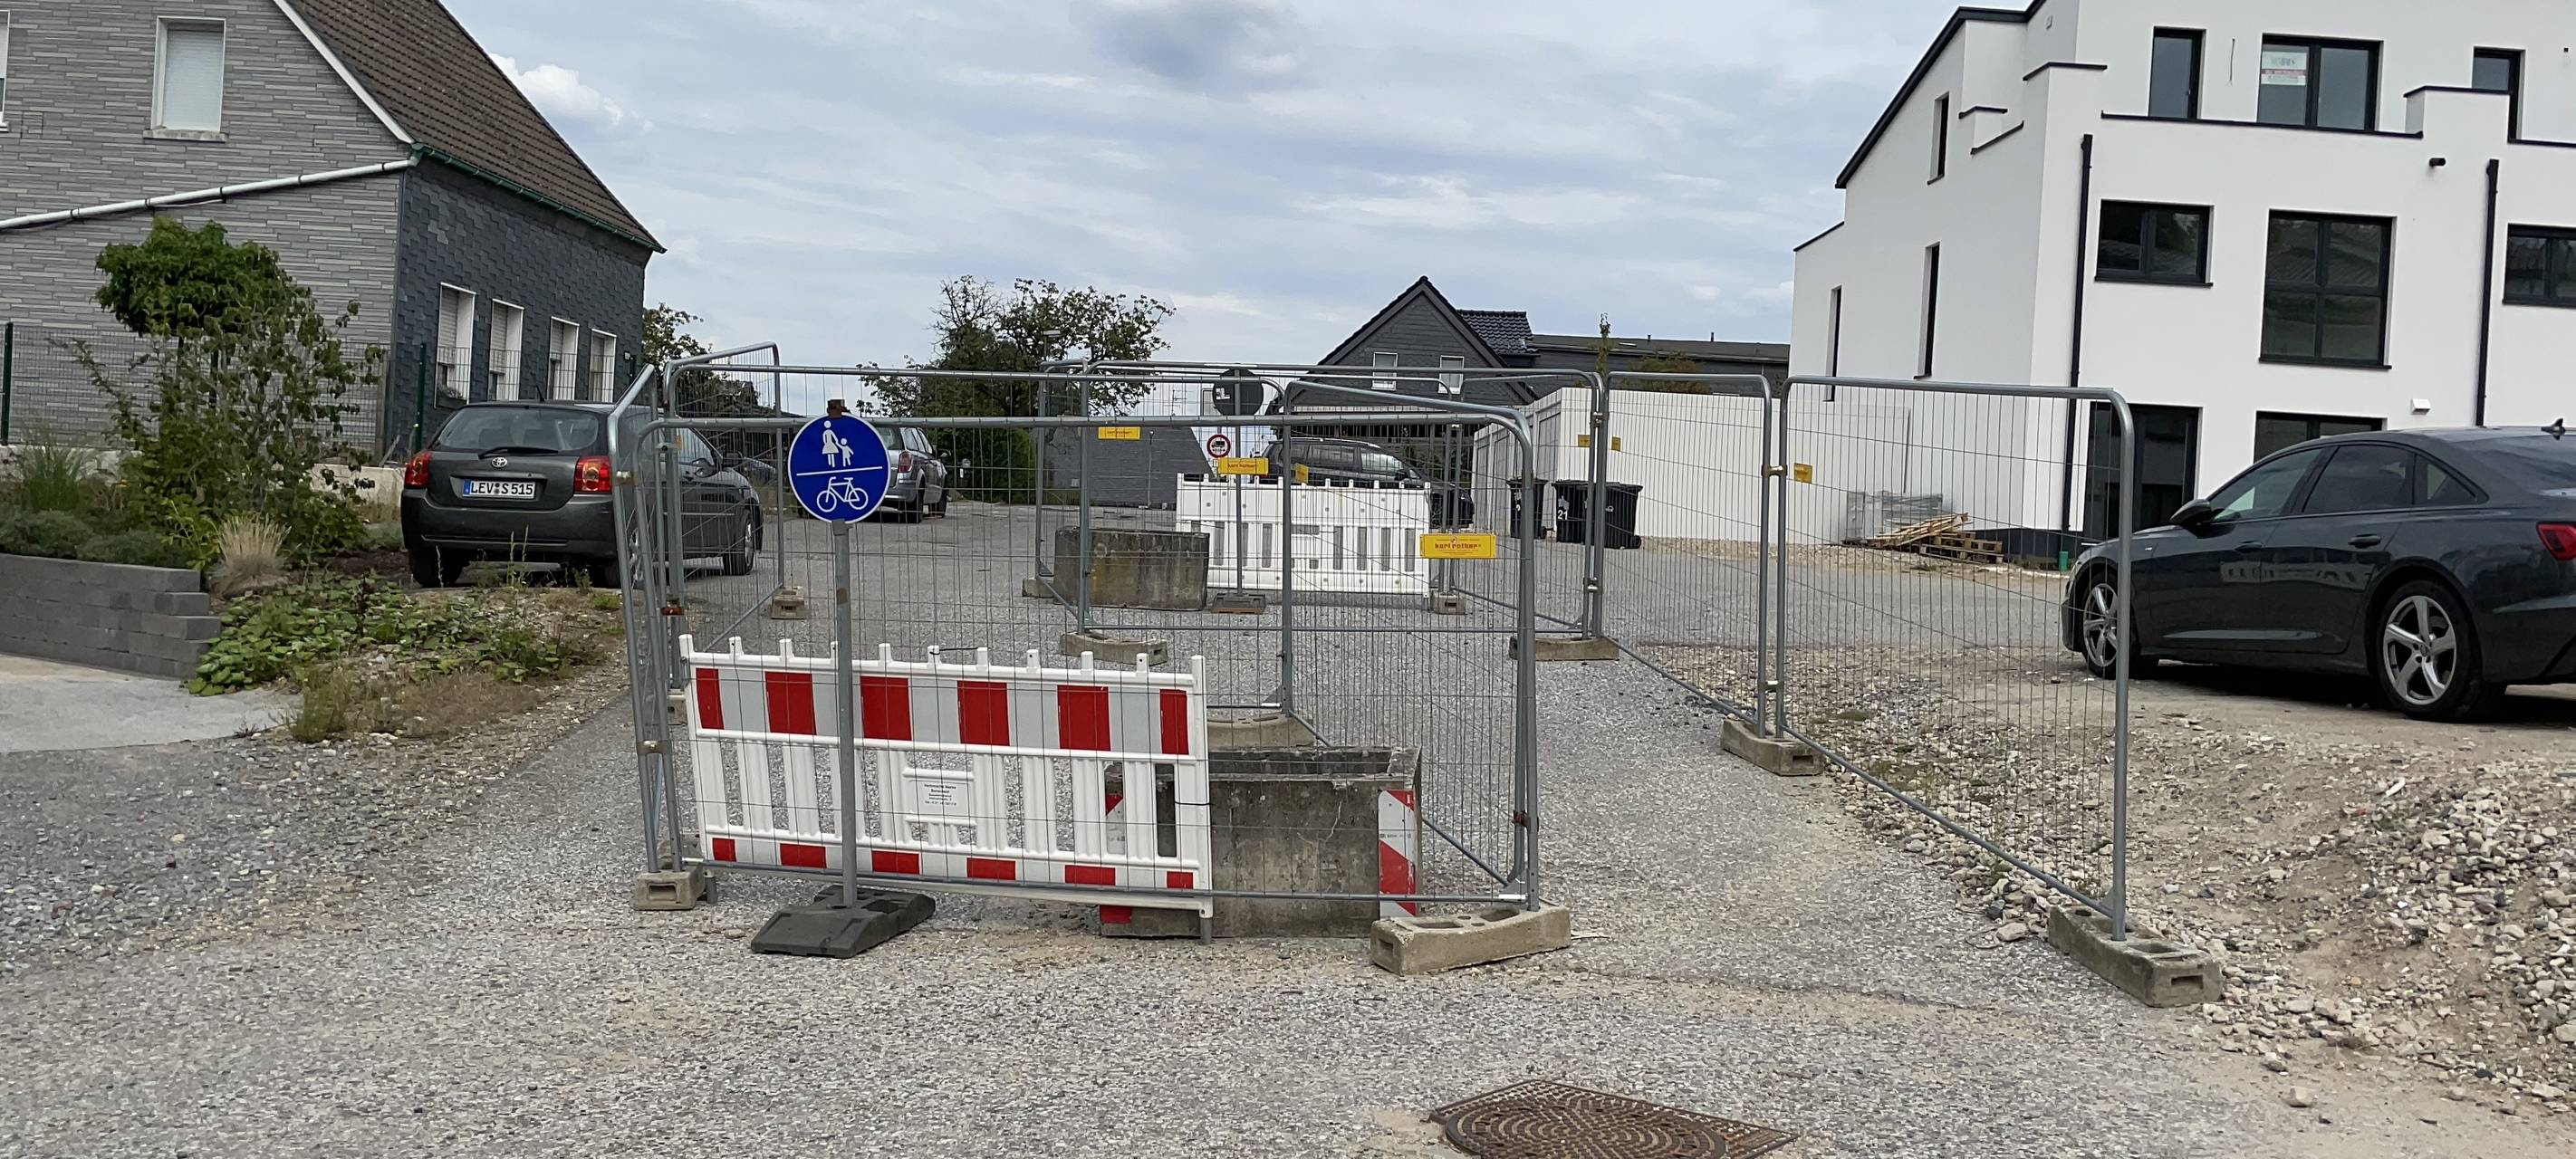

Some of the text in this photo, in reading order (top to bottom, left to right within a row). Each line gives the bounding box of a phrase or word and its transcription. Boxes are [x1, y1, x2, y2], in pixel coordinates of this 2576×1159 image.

[471, 482, 533, 495] LEV S 515
[1557, 509, 1568, 521] 21
